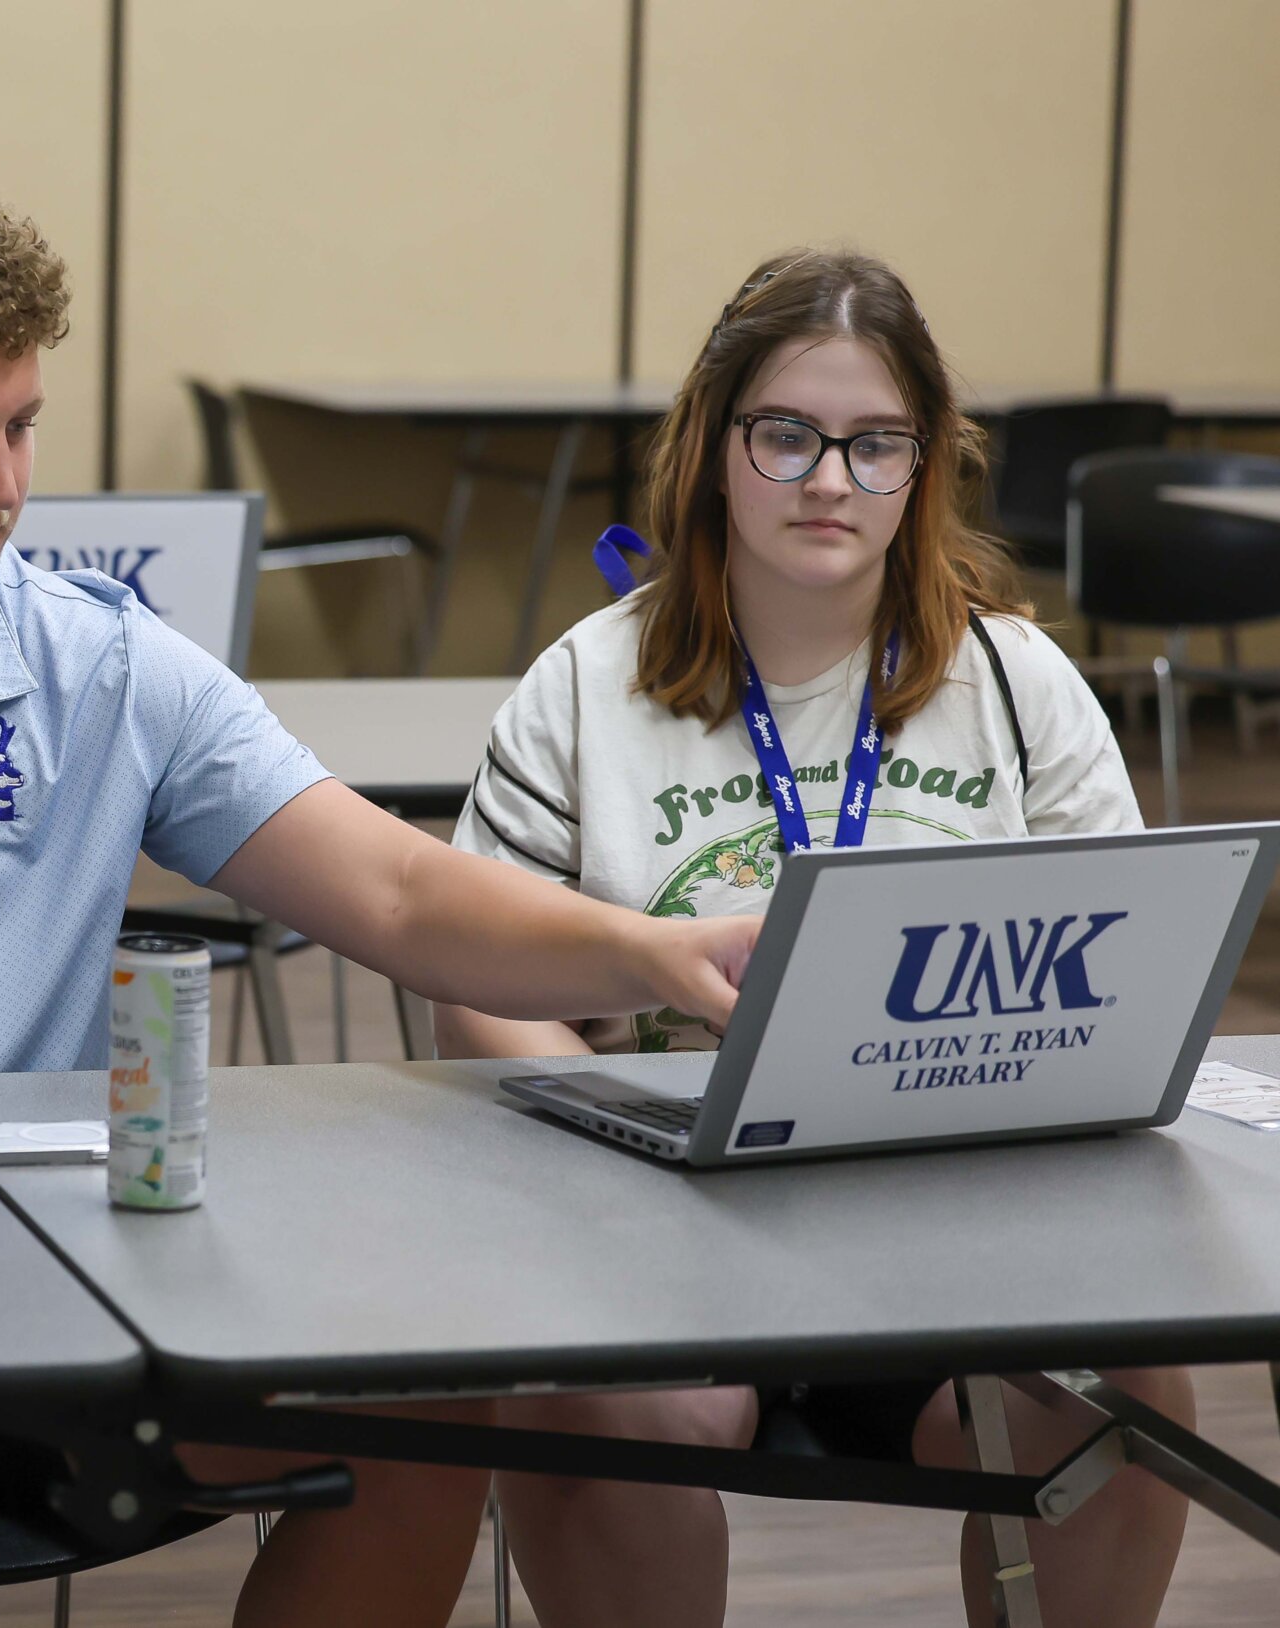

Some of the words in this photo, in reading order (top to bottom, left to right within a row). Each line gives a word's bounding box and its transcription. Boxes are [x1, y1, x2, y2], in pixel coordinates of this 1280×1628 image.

[753, 712, 774, 750] Lopers
[792, 760, 839, 784] and
[775, 774, 795, 814] Lopers
[847, 780, 866, 820] Lopers
[885, 911, 1129, 1023] UNK
[851, 1035, 972, 1066] CALVIN
[978, 1032, 1001, 1056] T.
[1009, 1025, 1097, 1053] RYAN
[891, 1059, 1035, 1092] LIBRARY
